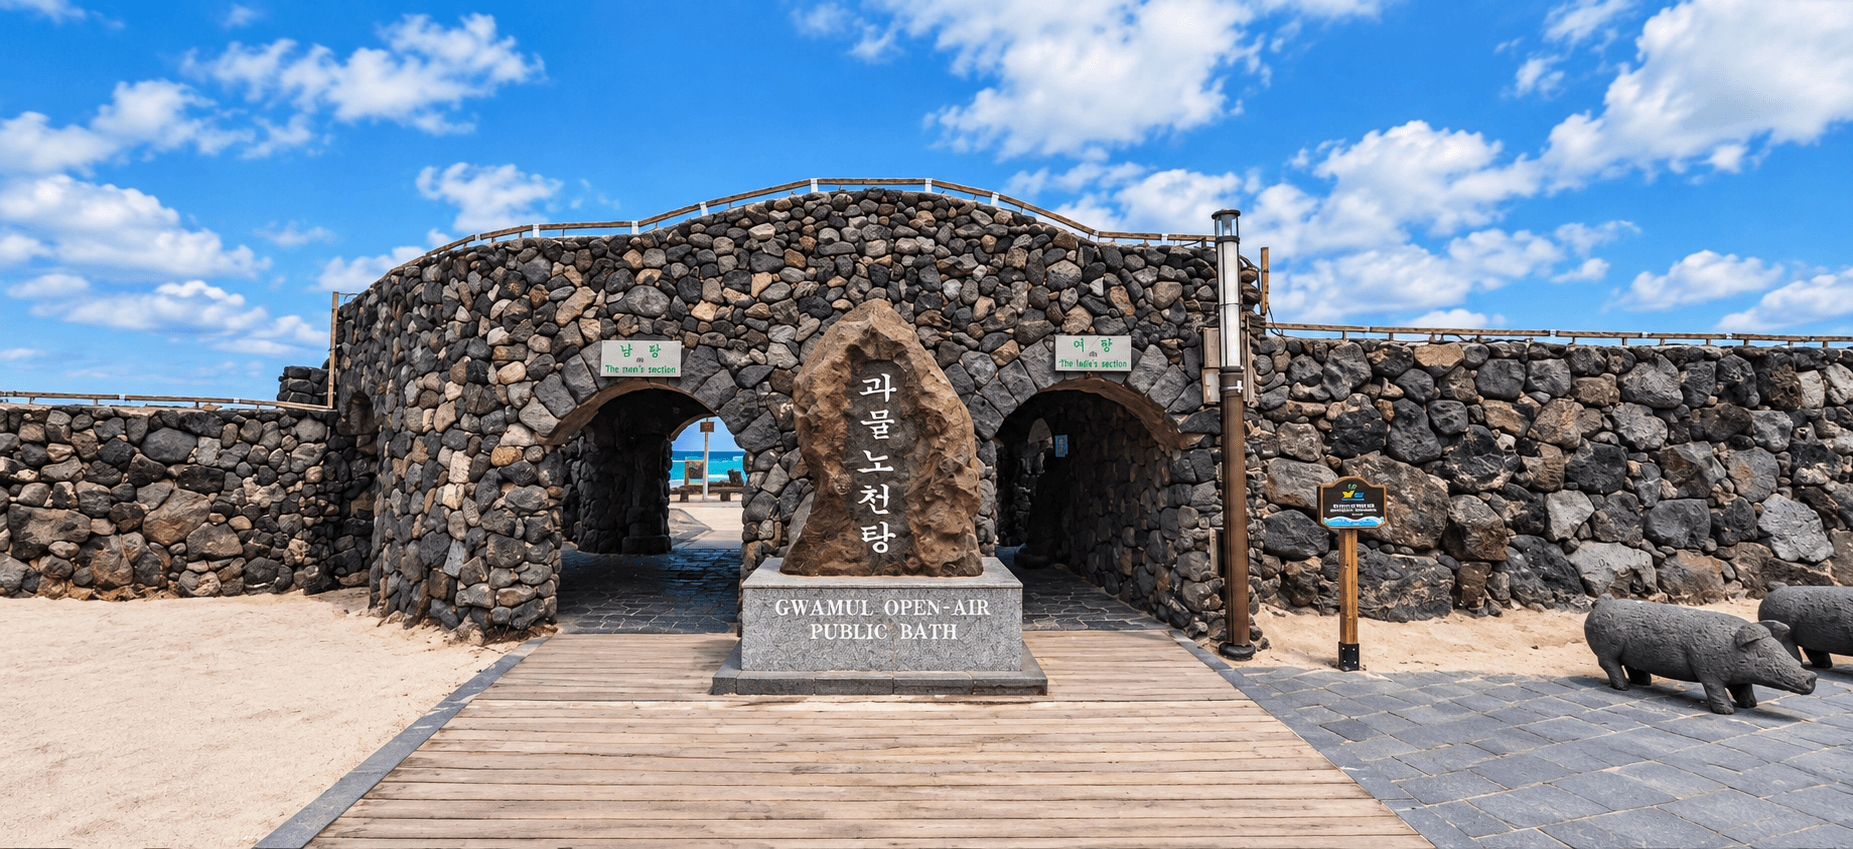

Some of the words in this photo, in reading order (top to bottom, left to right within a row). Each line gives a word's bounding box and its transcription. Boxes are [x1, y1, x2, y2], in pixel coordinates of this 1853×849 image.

[649, 343, 662, 359] 탕
[1073, 337, 1085, 353] 여
[1100, 337, 1113, 353] 탕
[605, 364, 620, 374] The
[648, 364, 677, 374] section
[1059, 358, 1074, 368] The
[1101, 359, 1128, 368] section
[856, 372, 898, 554] 과물노천탕
[774, 598, 874, 617] GWAMUL
[883, 598, 991, 617] OPEN-AIR
[809, 622, 888, 641] PUBLIC
[899, 622, 958, 641] BATH
